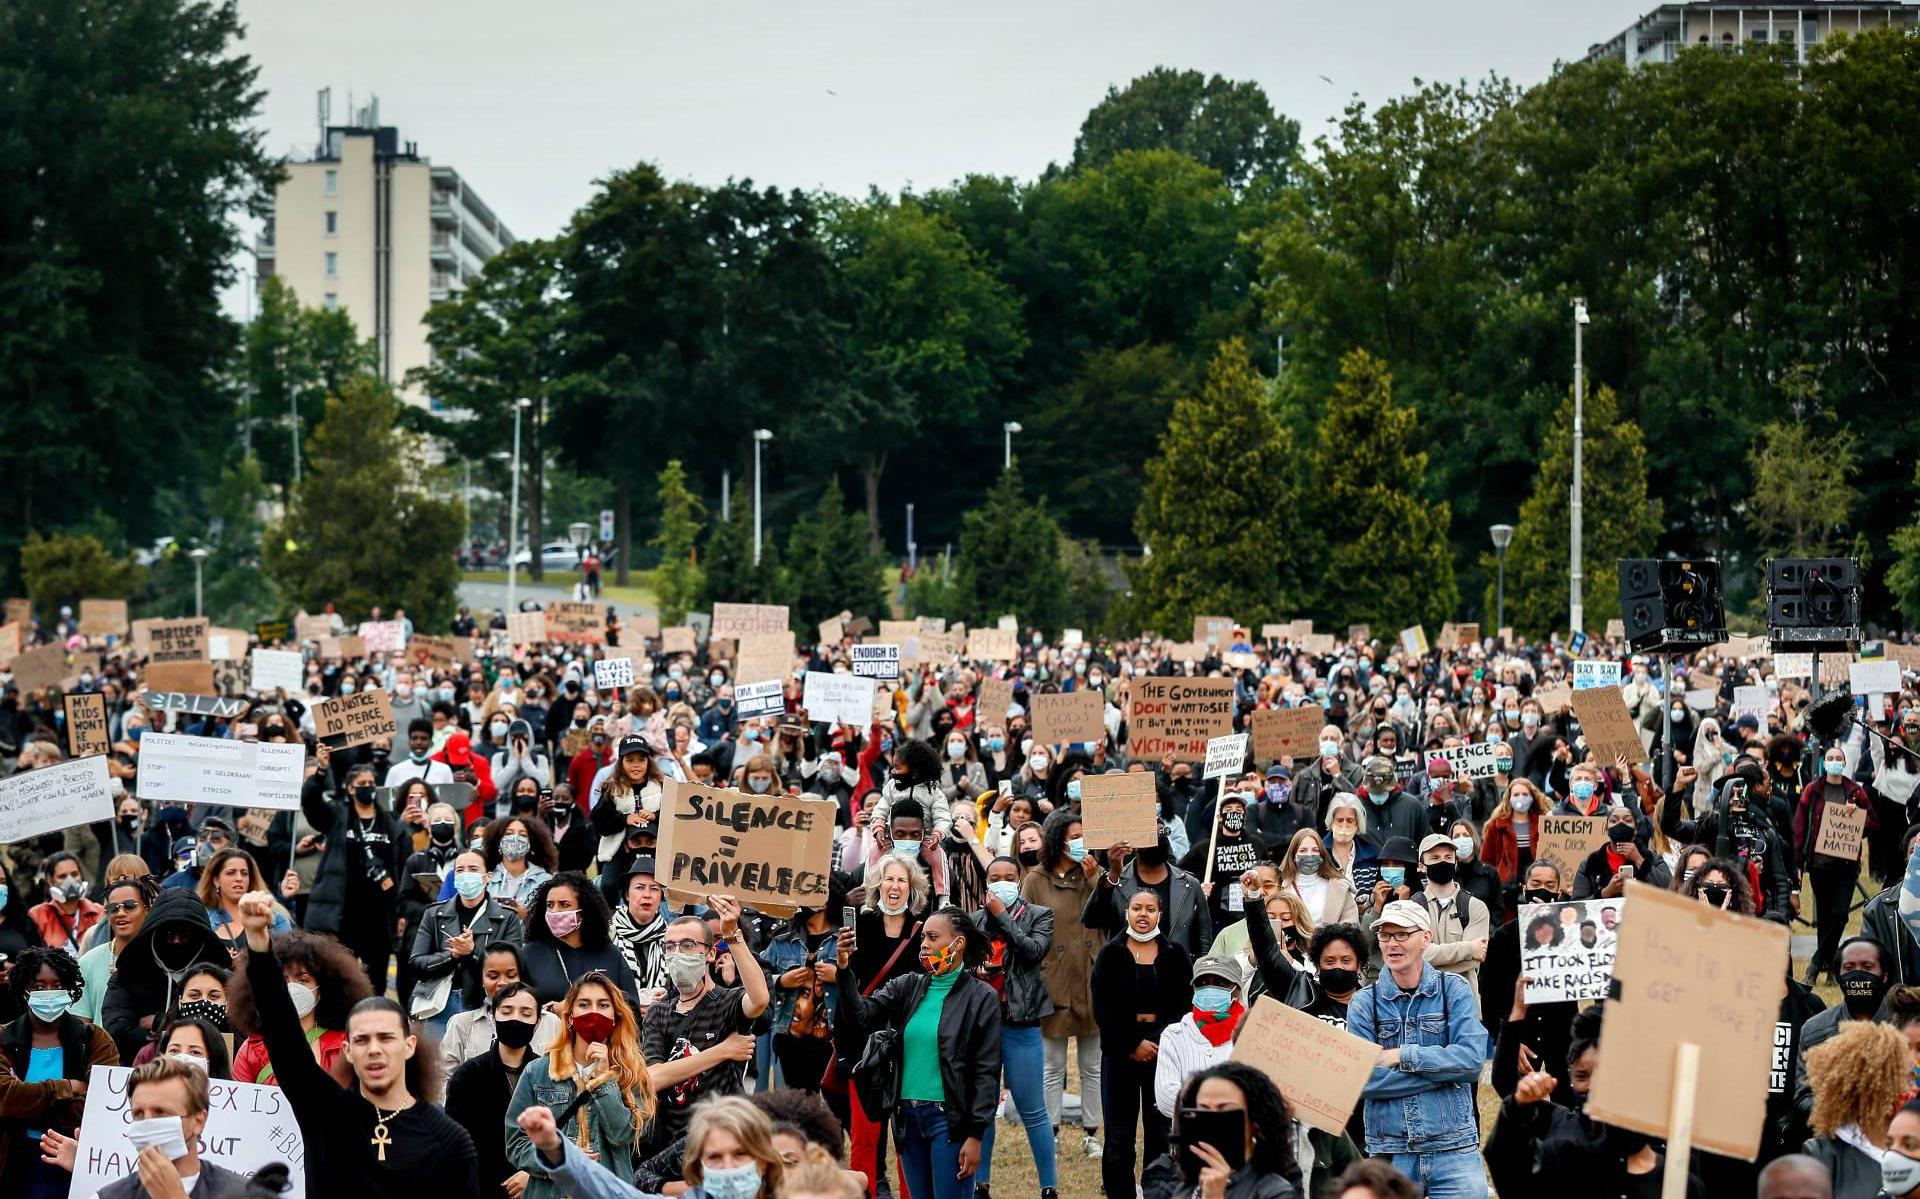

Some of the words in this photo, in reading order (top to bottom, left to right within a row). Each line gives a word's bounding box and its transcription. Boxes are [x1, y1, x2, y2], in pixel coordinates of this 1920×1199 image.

[854, 647, 886, 659] ENOUGH
[889, 647, 897, 658] IS
[855, 661, 898, 676] ENOUGH
[1576, 664, 1594, 675] BLACK
[1600, 665, 1617, 676] BLACK
[1141, 681, 1165, 698] THE
[1170, 685, 1234, 700] GOVERNMENT
[72, 697, 89, 707] MY
[166, 692, 240, 715] BLM
[322, 701, 339, 718] NO
[1170, 703, 1196, 713] WANT
[73, 708, 99, 719] KIDS
[327, 718, 343, 733] NO
[1149, 718, 1164, 728] BUT
[347, 730, 365, 742] THE
[364, 721, 396, 737] POLICE
[1210, 743, 1239, 755] MENING
[1430, 744, 1493, 760] SILENCE
[1455, 760, 1469, 769] IS
[675, 795, 815, 832] SILENCE
[1226, 812, 1243, 820] BLACK
[1543, 819, 1593, 835] RACISM
[1829, 819, 1860, 834] WOMEN
[1825, 829, 1856, 842] LIVES
[1216, 843, 1254, 855] ZWARTE
[1217, 853, 1238, 863] PIET
[1248, 851, 1256, 860] IS
[672, 852, 828, 896] PRIVELEGE
[1524, 955, 1545, 971] IT
[1548, 953, 1584, 968] TOOK
[1526, 975, 1560, 990] MAKE
[1566, 986, 1611, 999] NEWS
[1648, 981, 1686, 1004] GET
[1261, 1012, 1281, 1025] WE
[1285, 1018, 1316, 1036] HAVE
[249, 1087, 281, 1115] IS
